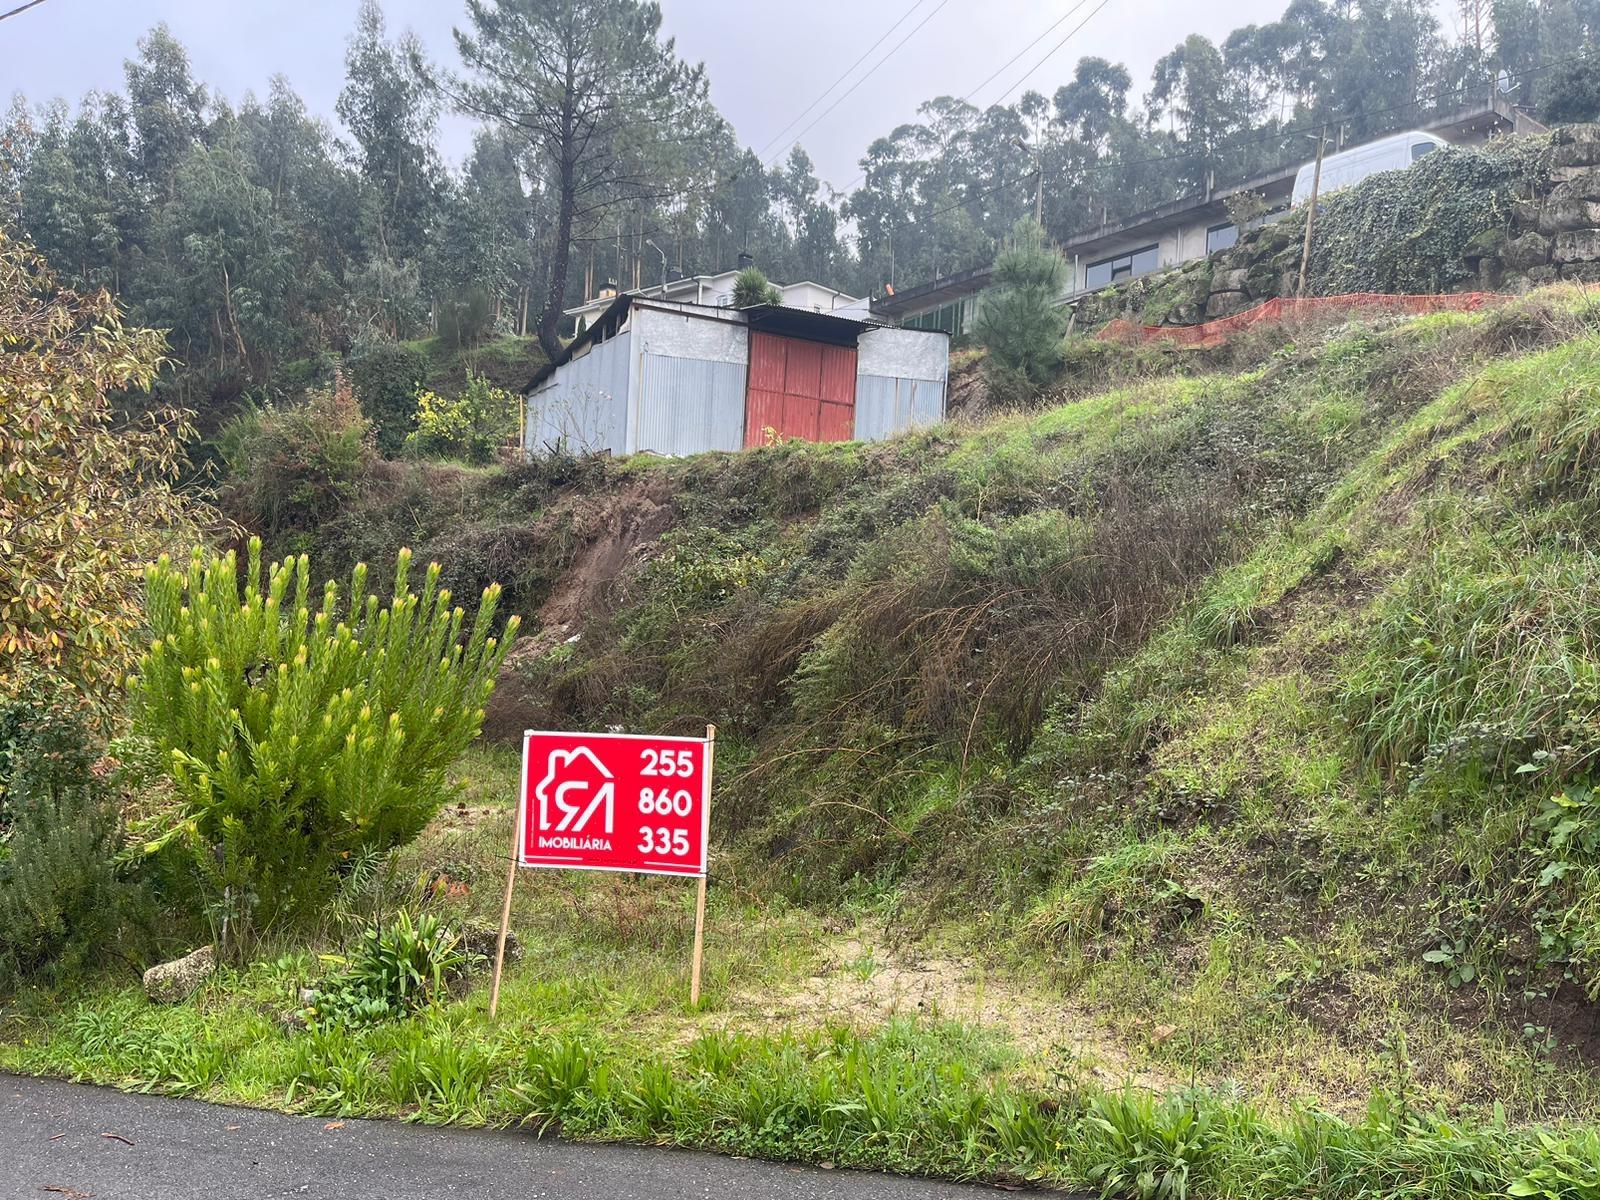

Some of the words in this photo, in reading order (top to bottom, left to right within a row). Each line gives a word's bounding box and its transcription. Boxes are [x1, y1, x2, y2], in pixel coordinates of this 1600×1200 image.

[639, 748, 694, 778] 255
[638, 787, 693, 817] 860
[538, 834, 613, 851] IMOBILIÁRIA
[637, 826, 690, 856] 335
